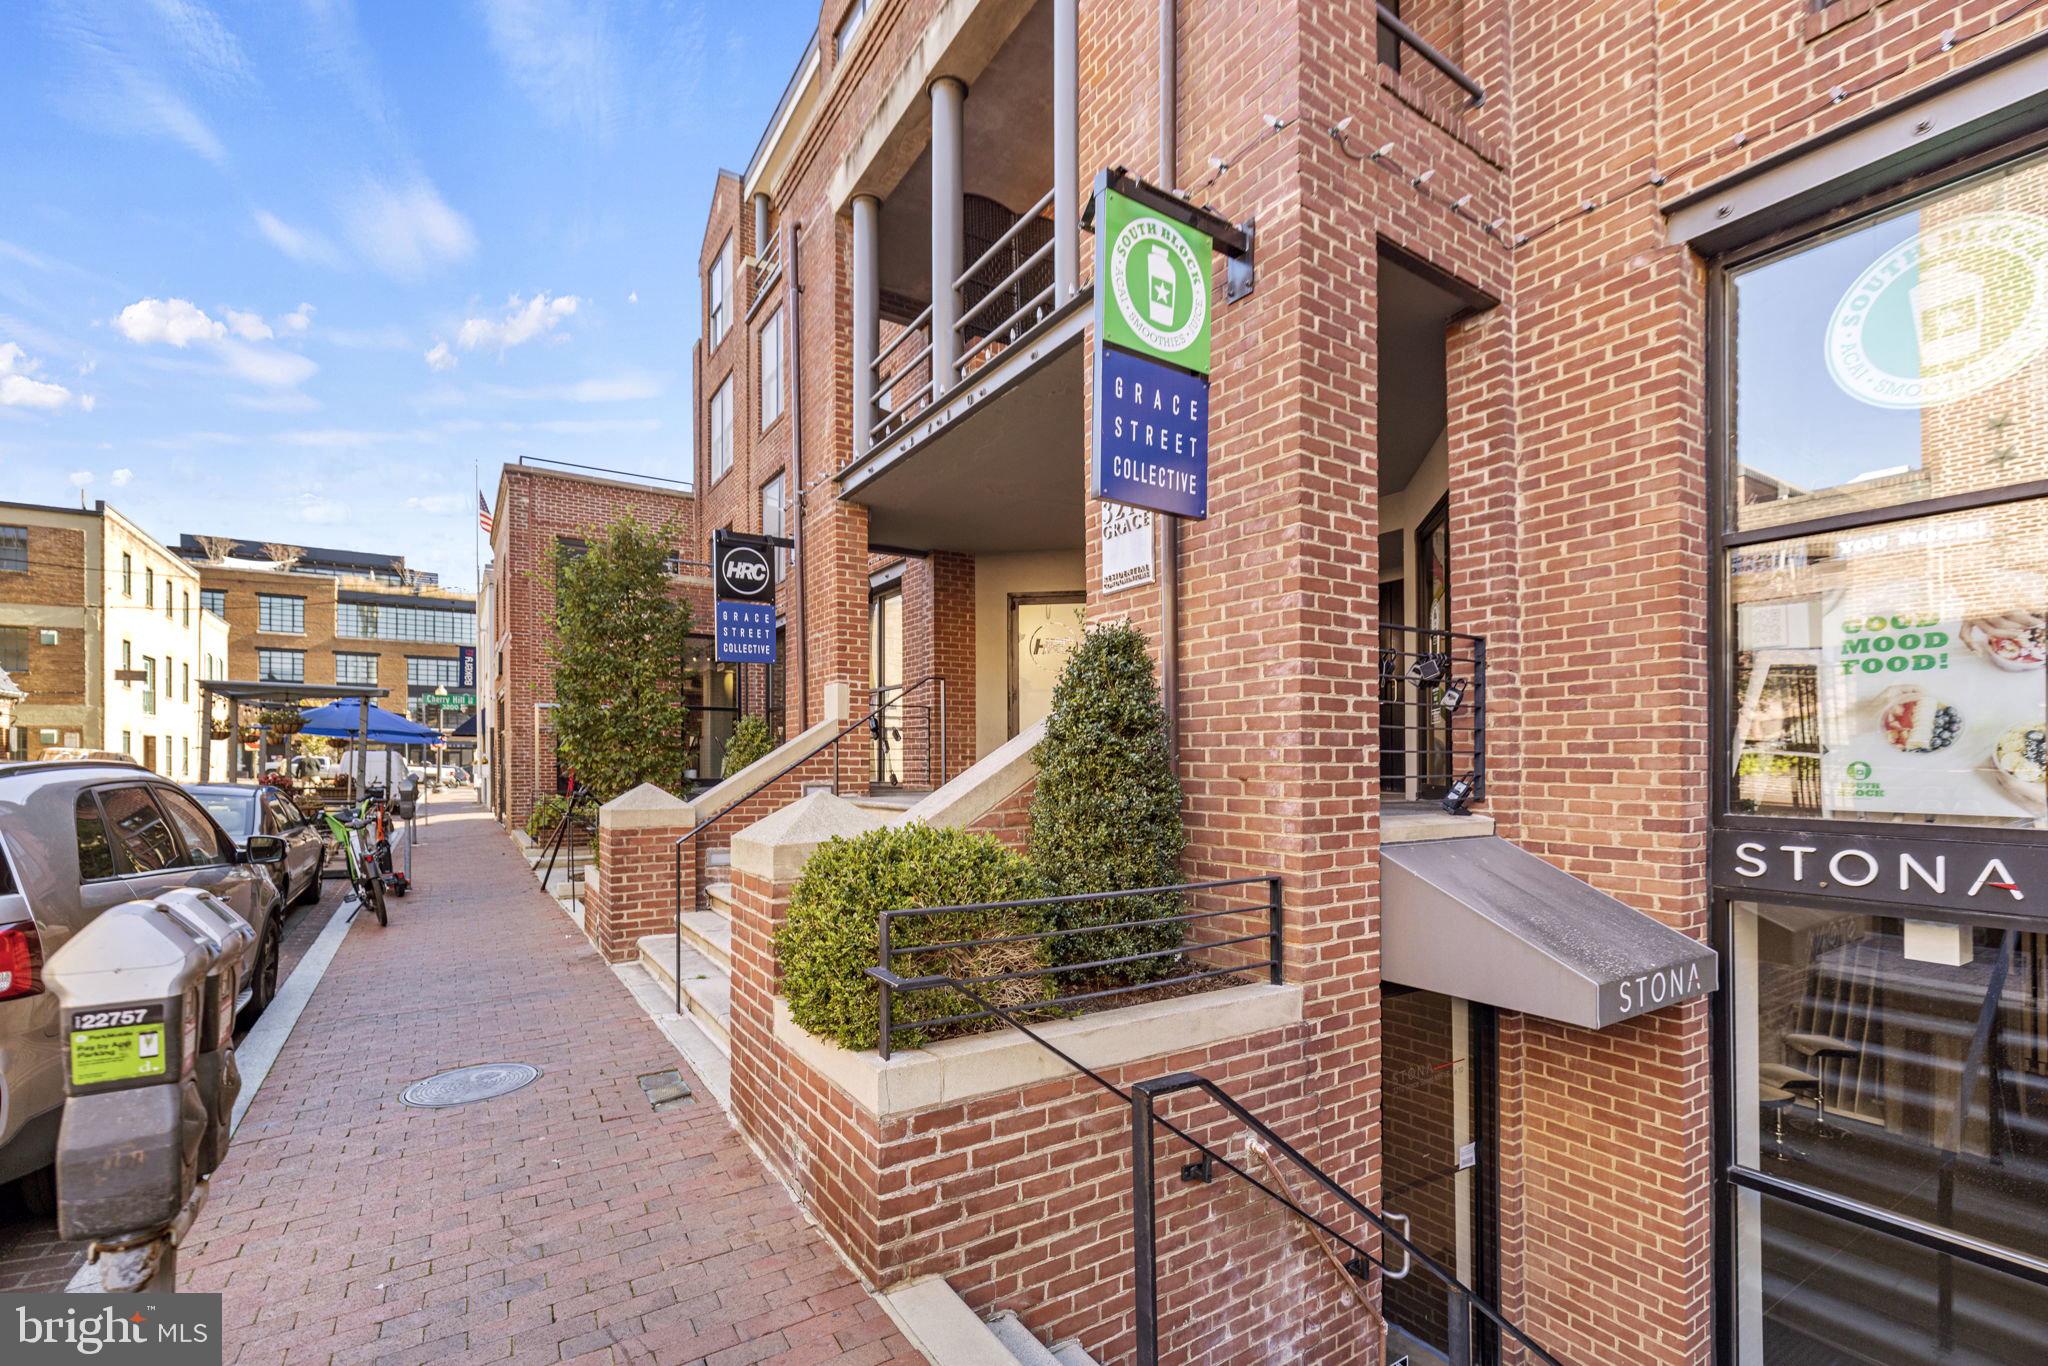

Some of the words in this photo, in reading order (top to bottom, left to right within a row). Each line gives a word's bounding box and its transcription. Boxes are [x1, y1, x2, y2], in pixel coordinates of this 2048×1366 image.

[1117, 223, 1157, 257] SOUTH
[1161, 227, 1200, 285] BLOCK
[1128, 312, 1186, 347] SMOOTHIES
[1115, 376, 1198, 422] GRACE
[1114, 416, 1198, 458] STREET
[1113, 455, 1197, 495] COLLECTIVE
[1103, 512, 1150, 540] GRACE
[726, 561, 767, 581] HRC
[722, 610, 770, 624] GRACE
[723, 627, 770, 639] STREET
[1841, 632, 1949, 654] MOOD
[723, 642, 770, 655] COLLECTIVE
[1840, 653, 1948, 675] FOOD!
[426, 694, 450, 704] Cherry
[452, 695, 466, 704] Hill
[1734, 842, 2025, 901] STONA
[1619, 963, 1700, 1013] STONA
[81, 1008, 148, 1030] 22757
